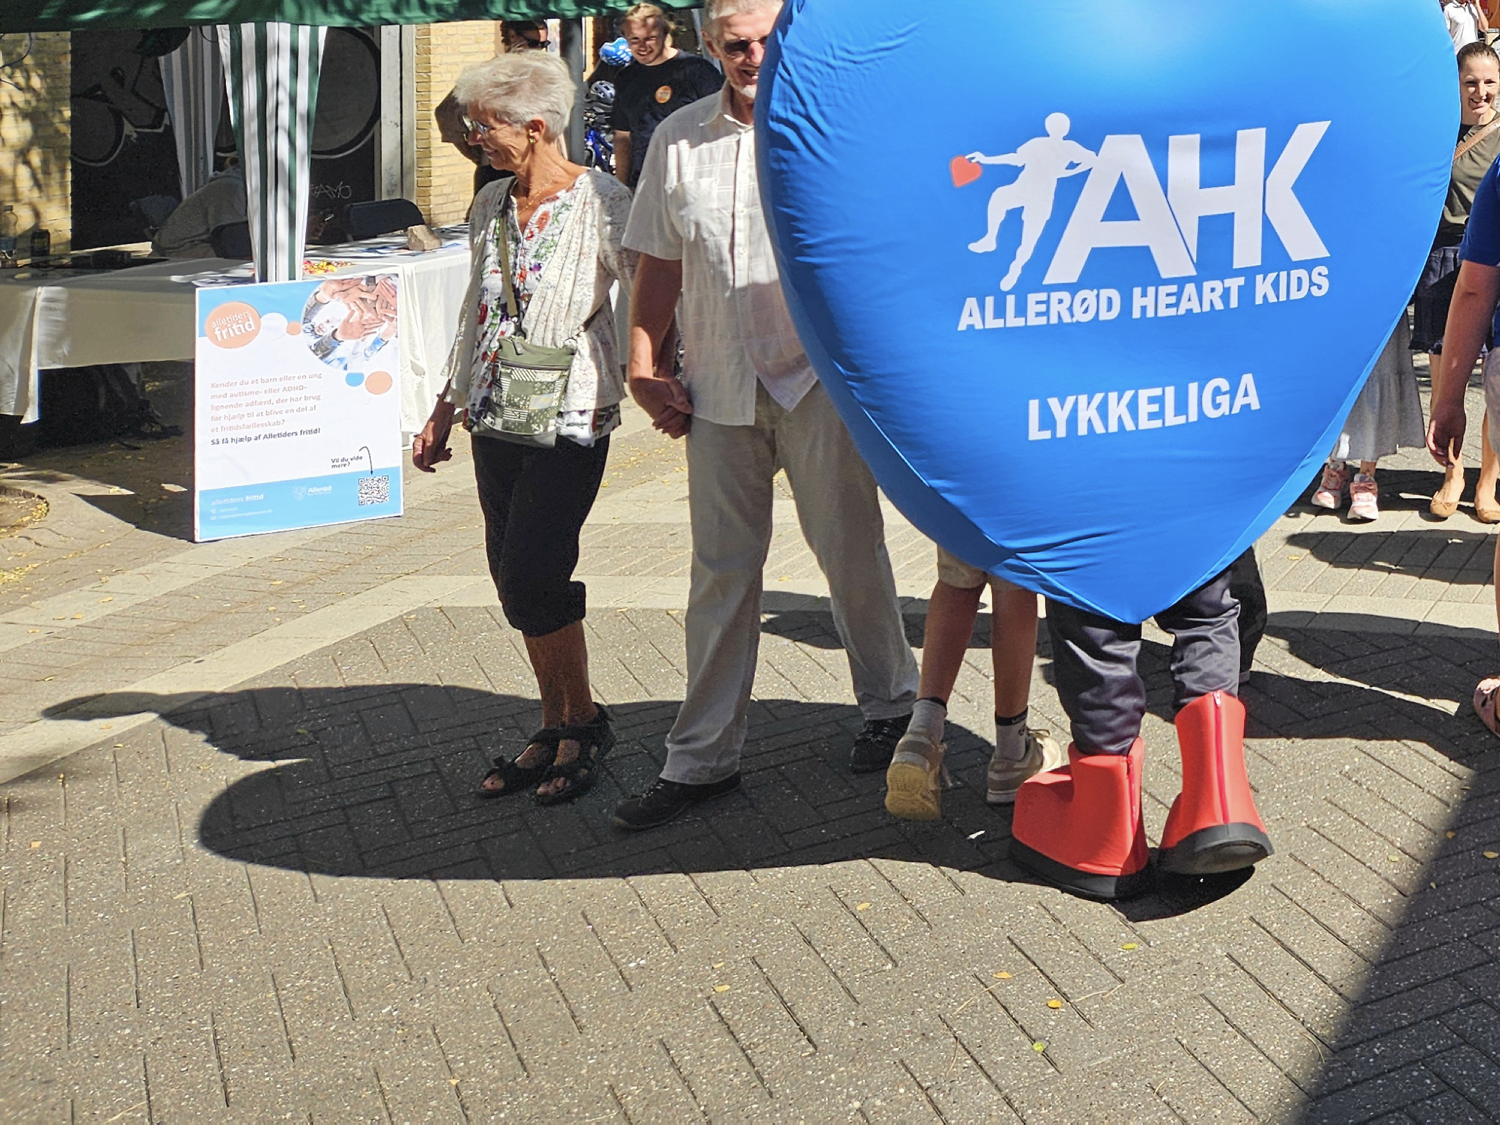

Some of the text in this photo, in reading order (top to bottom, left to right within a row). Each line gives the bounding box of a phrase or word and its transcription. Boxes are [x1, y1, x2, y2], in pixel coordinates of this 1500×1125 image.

[1043, 121, 1331, 285] AHK
[958, 265, 1330, 331] ALLERØD HEART KIDS
[211, 310, 251, 329] alletiders
[214, 316, 256, 342] fritid
[210, 380, 238, 389] Kender
[260, 377, 278, 385] barn
[279, 374, 296, 382] eller
[210, 384, 307, 400] med autisme- eller ADHD-
[210, 402, 243, 412] lignende
[289, 395, 302, 403] har
[303, 394, 321, 402] brug
[1028, 373, 1260, 441] LYKKELIGA
[223, 412, 245, 422] hjælp
[265, 408, 284, 416] blive
[296, 405, 308, 413] del
[309, 404, 317, 412] af
[230, 435, 252, 444] hjælp
[253, 433, 261, 441] af
[262, 430, 298, 440] Alletiders
[299, 427, 321, 436] fritid!
[331, 461, 351, 469] mere?
